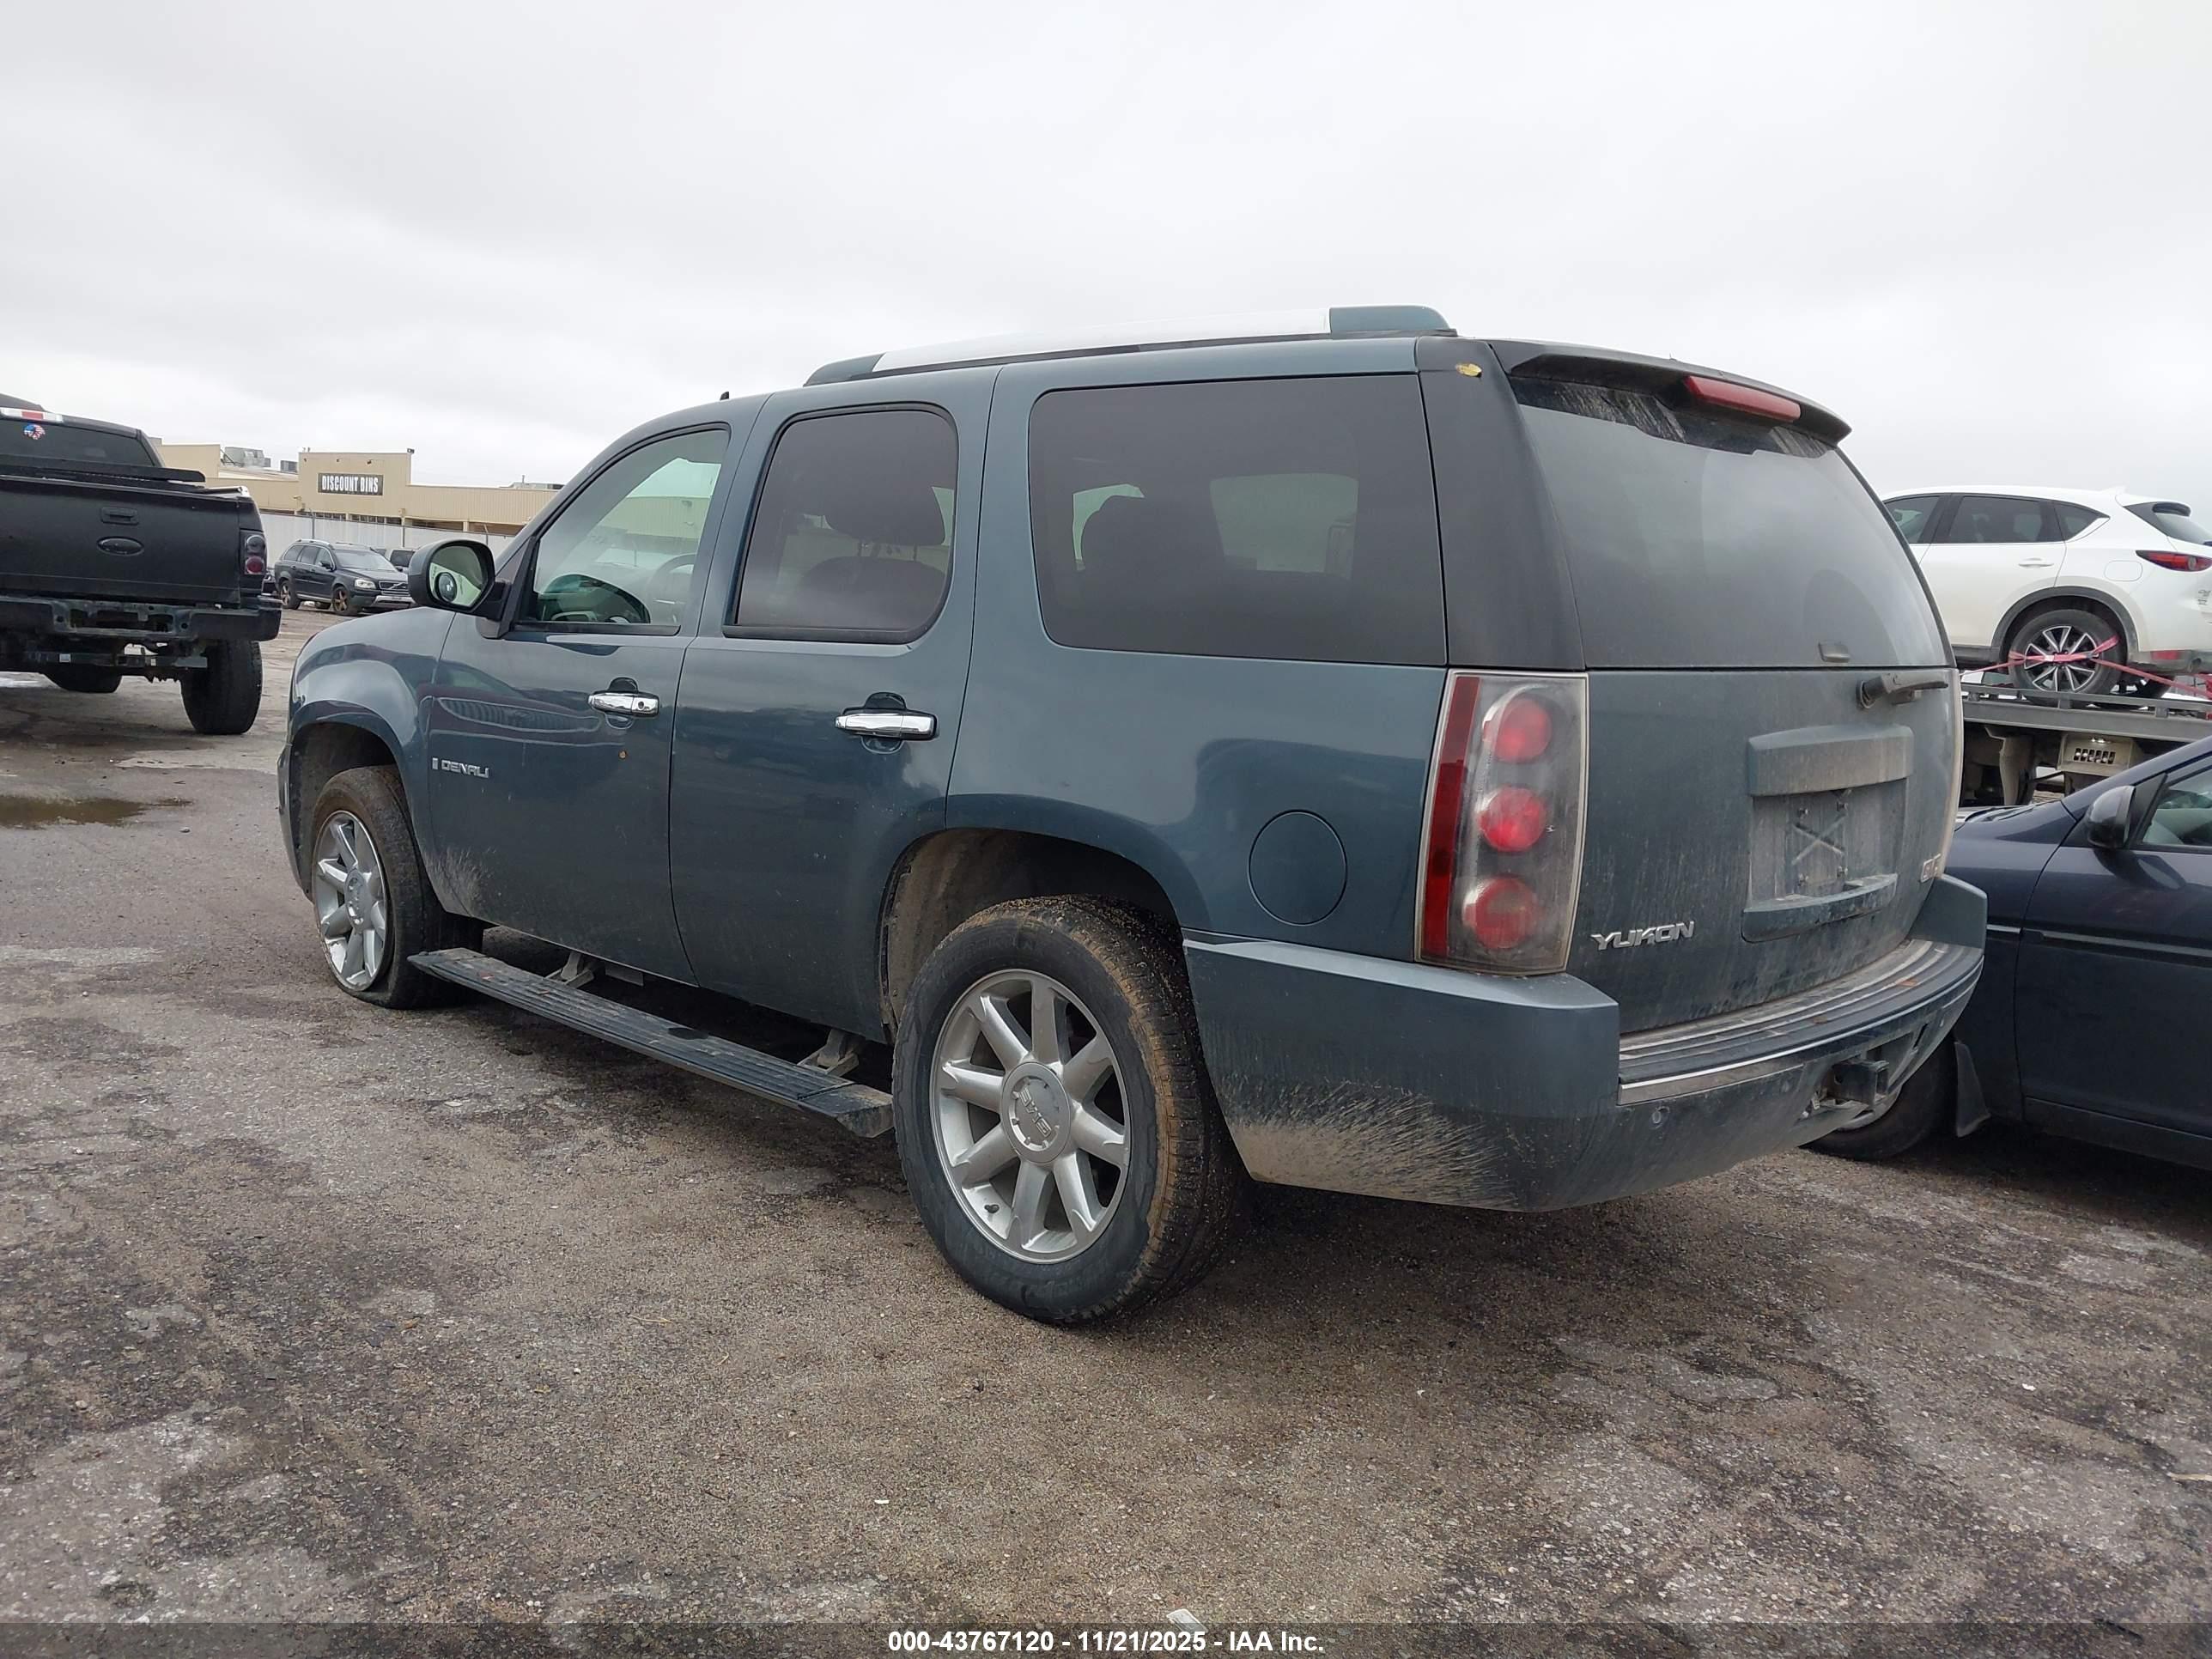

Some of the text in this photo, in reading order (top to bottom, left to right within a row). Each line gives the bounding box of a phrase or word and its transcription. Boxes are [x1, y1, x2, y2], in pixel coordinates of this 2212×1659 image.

[321, 475, 359, 492] DISCOUNT
[441, 759, 489, 778] DENALI
[1590, 921, 1694, 951] YUKON
